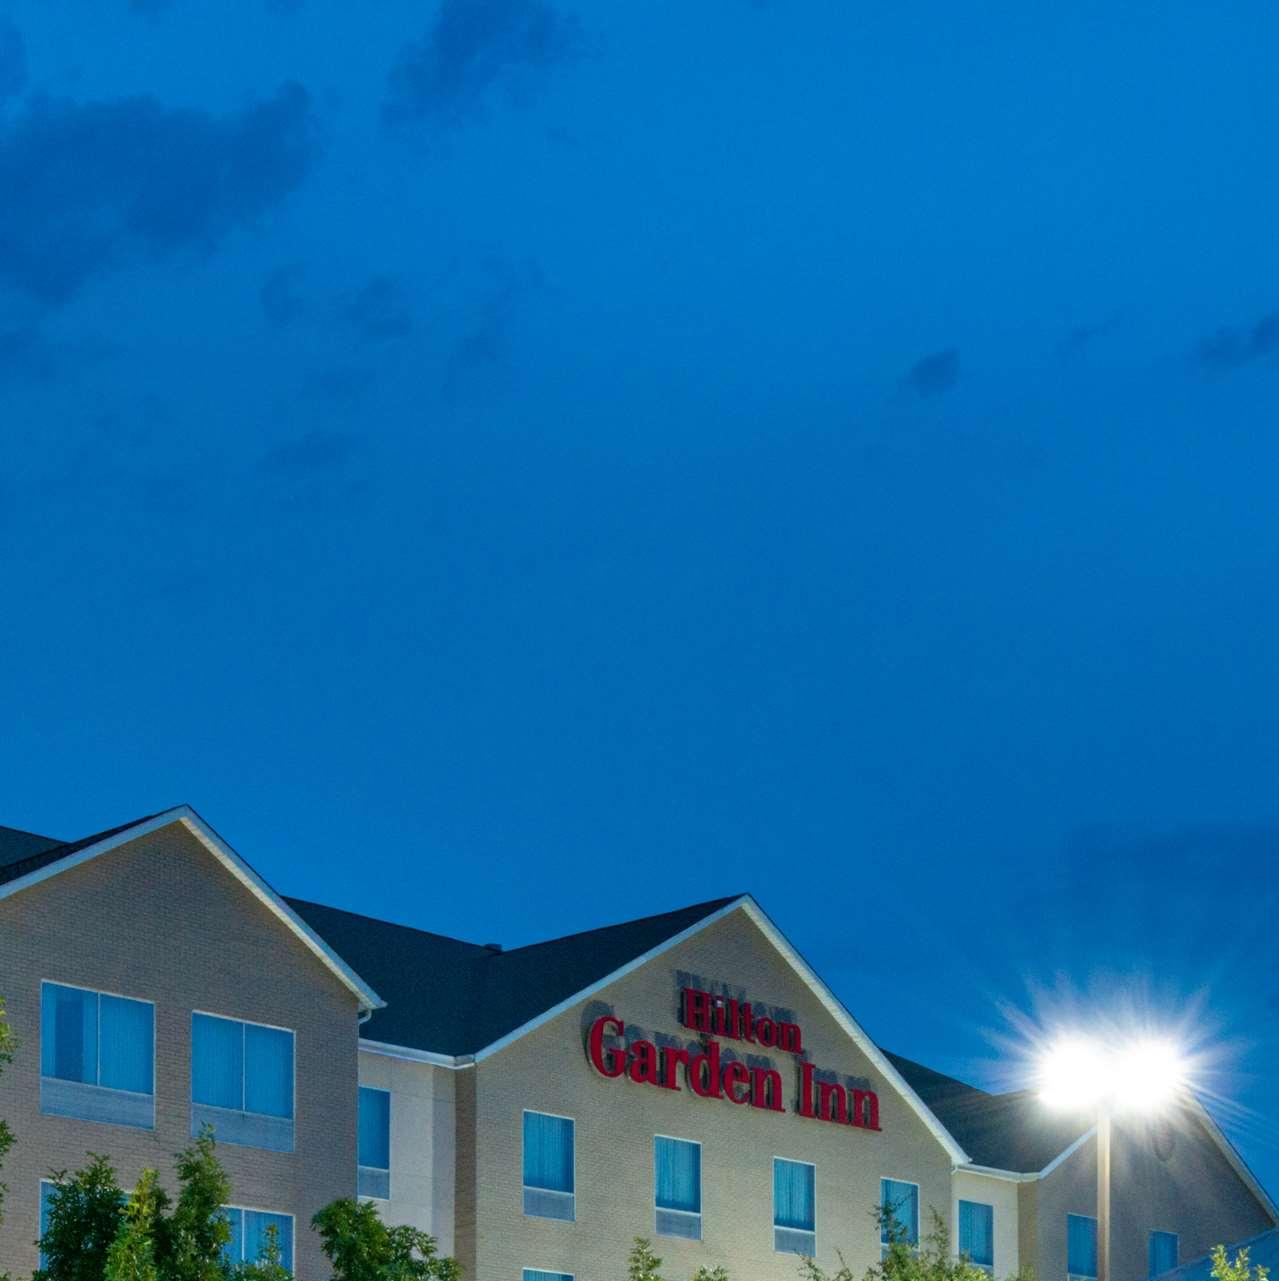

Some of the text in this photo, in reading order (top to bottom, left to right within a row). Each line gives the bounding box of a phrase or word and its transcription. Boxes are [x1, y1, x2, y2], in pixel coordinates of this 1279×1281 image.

[681, 987, 802, 1055] Hilton
[588, 1015, 882, 1132] Garden Inn
